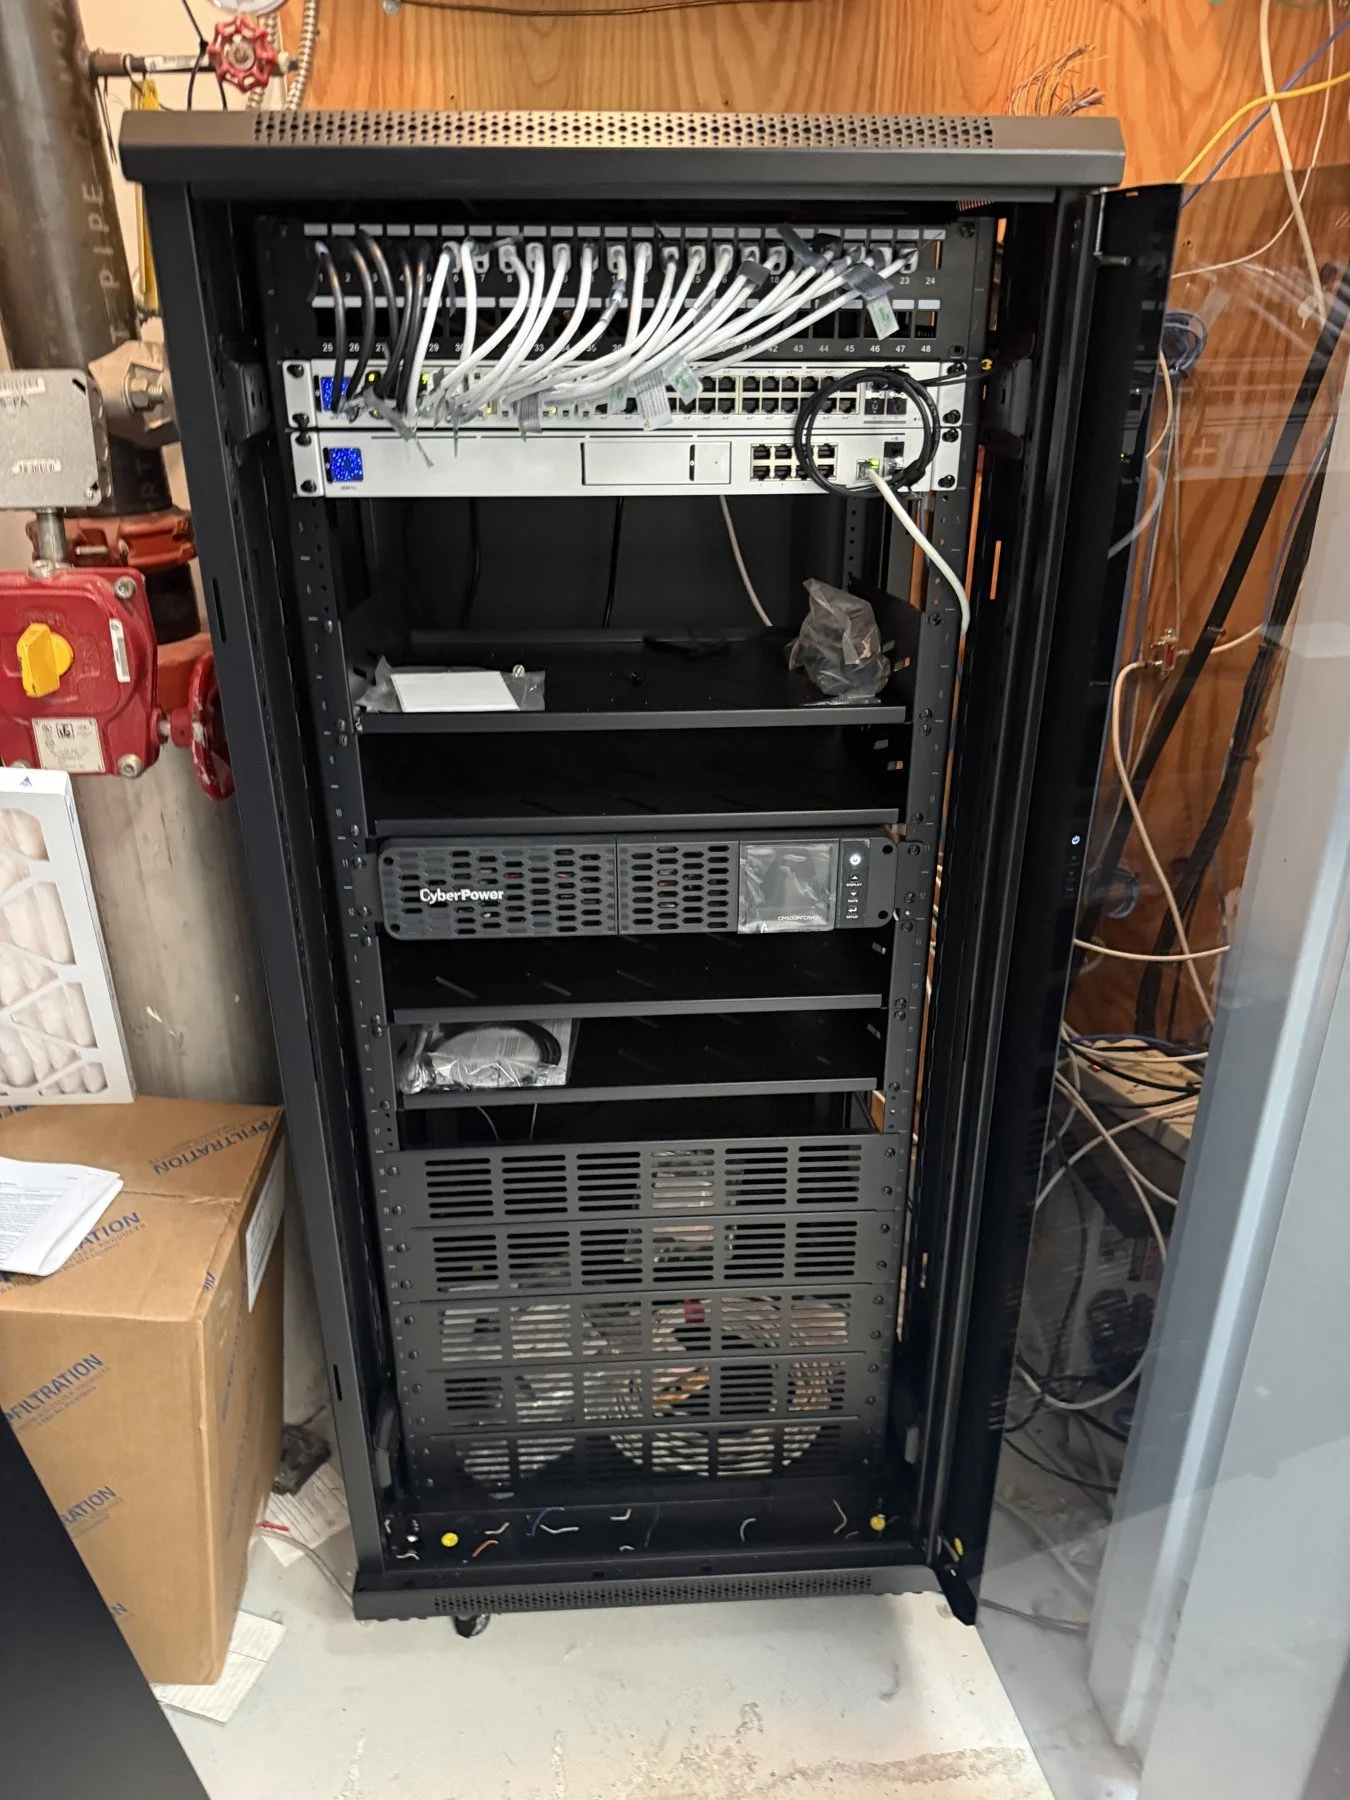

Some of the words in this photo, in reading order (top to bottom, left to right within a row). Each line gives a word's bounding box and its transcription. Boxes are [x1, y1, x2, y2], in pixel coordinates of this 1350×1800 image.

[479, 273, 487, 283] 7
[506, 273, 514, 284] 8
[899, 276, 911, 286] 23
[924, 276, 937, 286] 24
[792, 344, 804, 354] 43
[818, 344, 830, 354] 44
[843, 344, 856, 354] 45
[869, 344, 881, 354] 46
[894, 344, 906, 354] 47
[920, 344, 932, 354] 48
[420, 887, 504, 905] CyberPower
[153, 1120, 271, 1175] PFILTRATION
